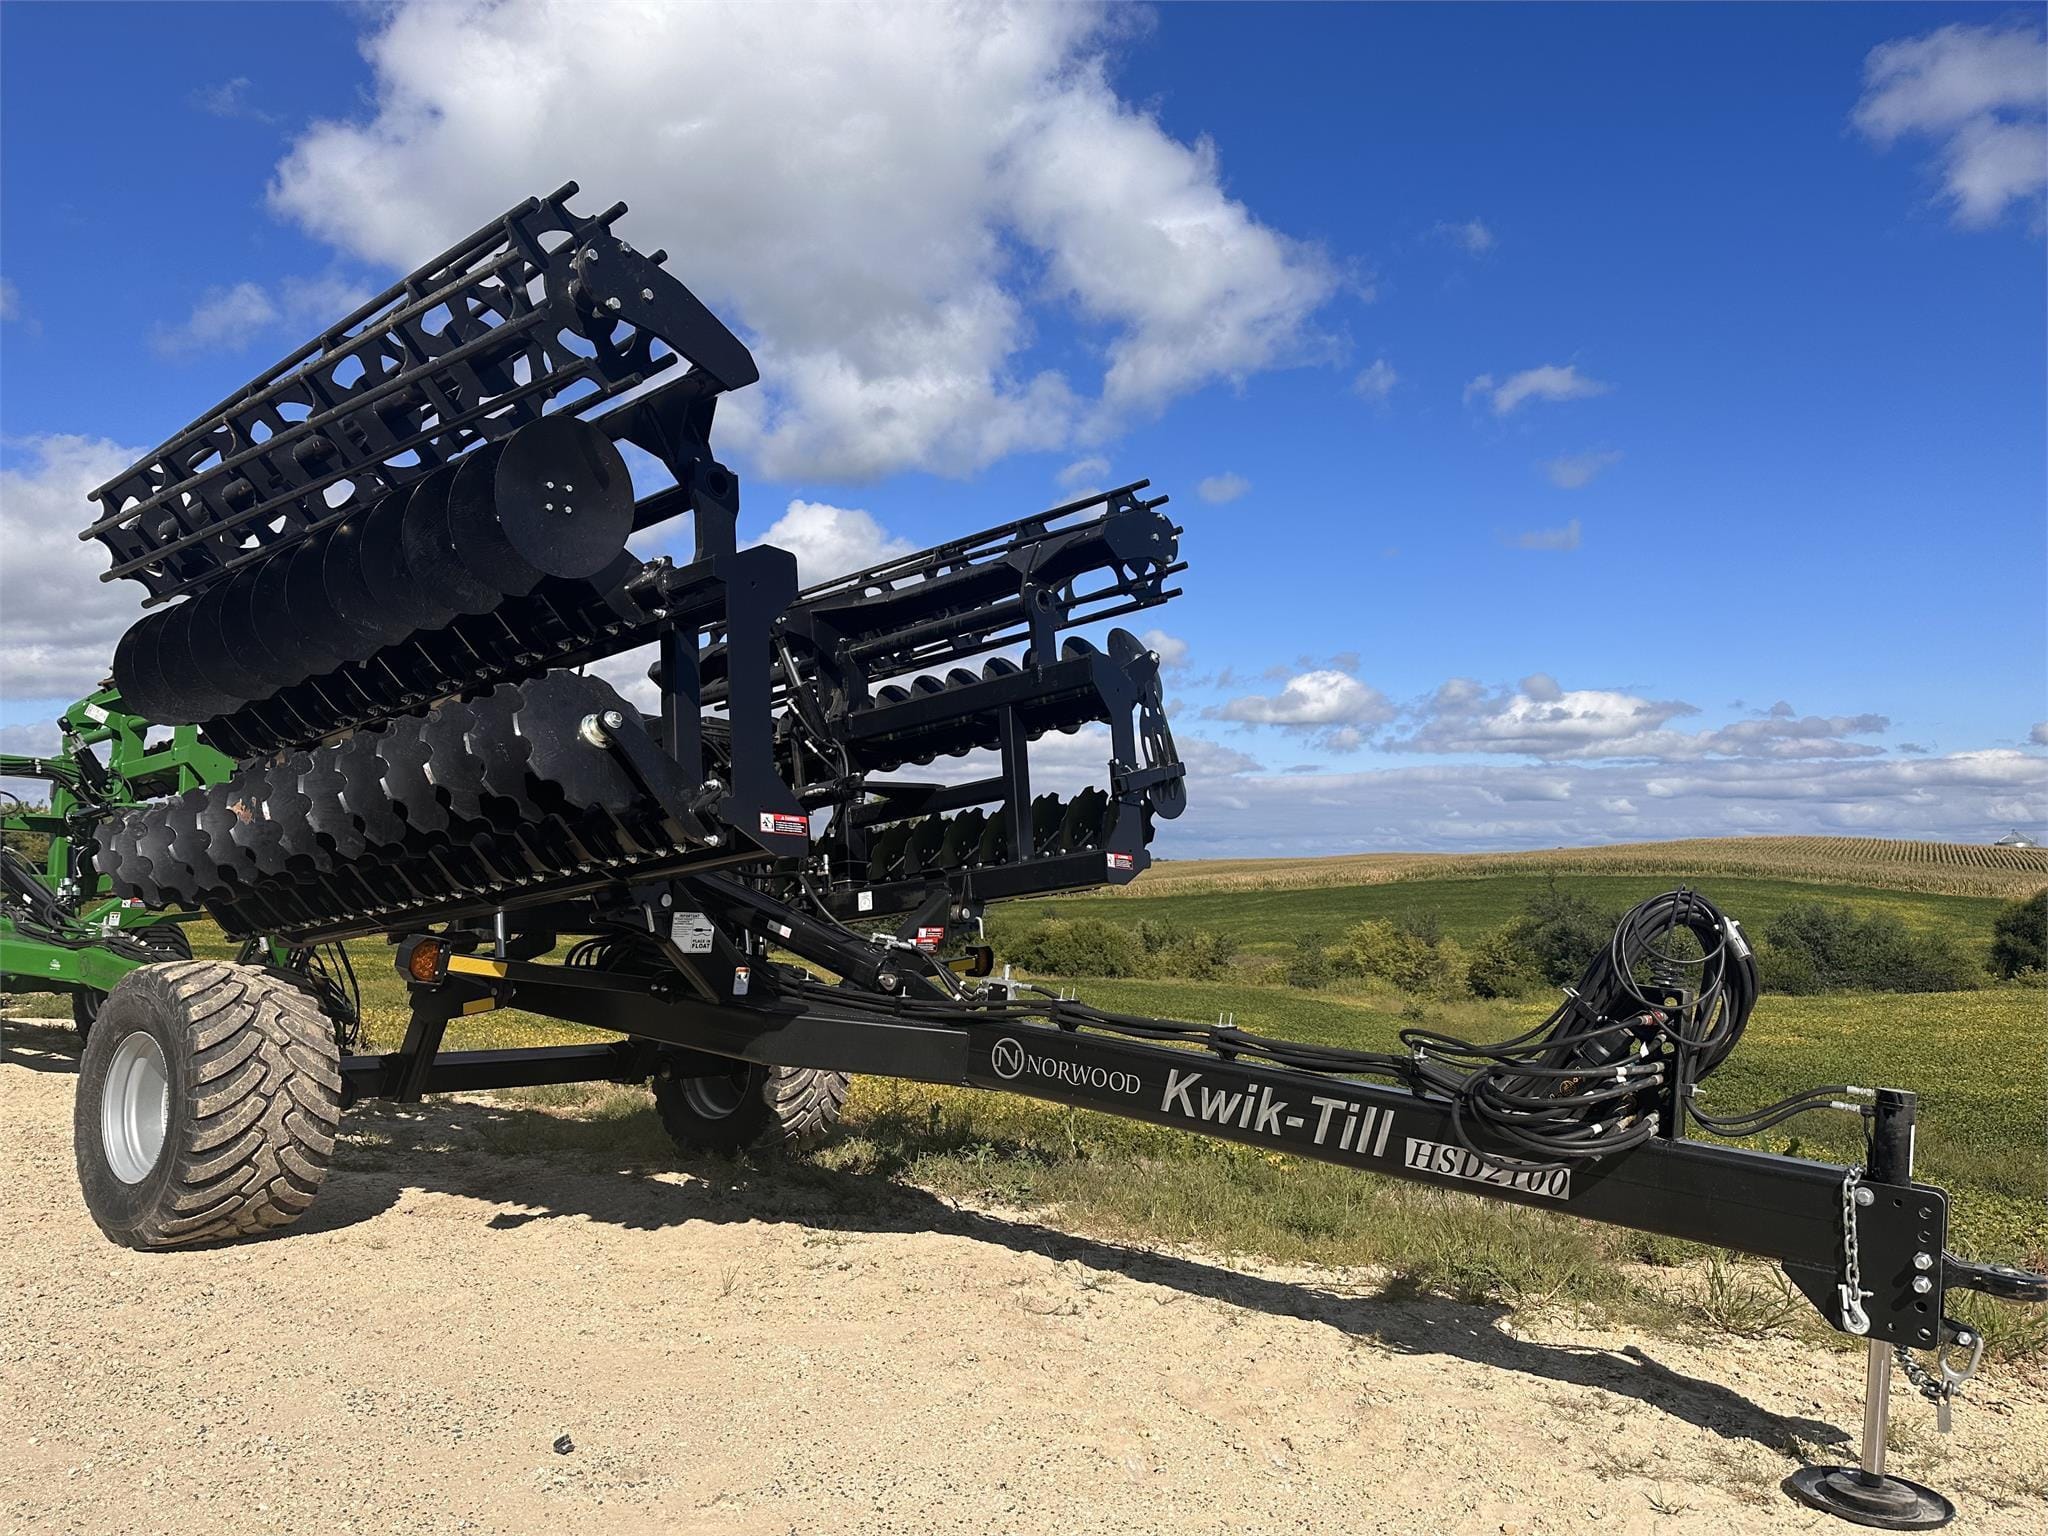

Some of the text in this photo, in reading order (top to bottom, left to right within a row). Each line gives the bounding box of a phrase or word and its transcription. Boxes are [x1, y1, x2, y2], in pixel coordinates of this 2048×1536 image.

[1026, 1054, 1141, 1094] NORWOOD
[1160, 1068, 1395, 1157] Kwik-Till
[1407, 1140, 1568, 1196] HSD2100
